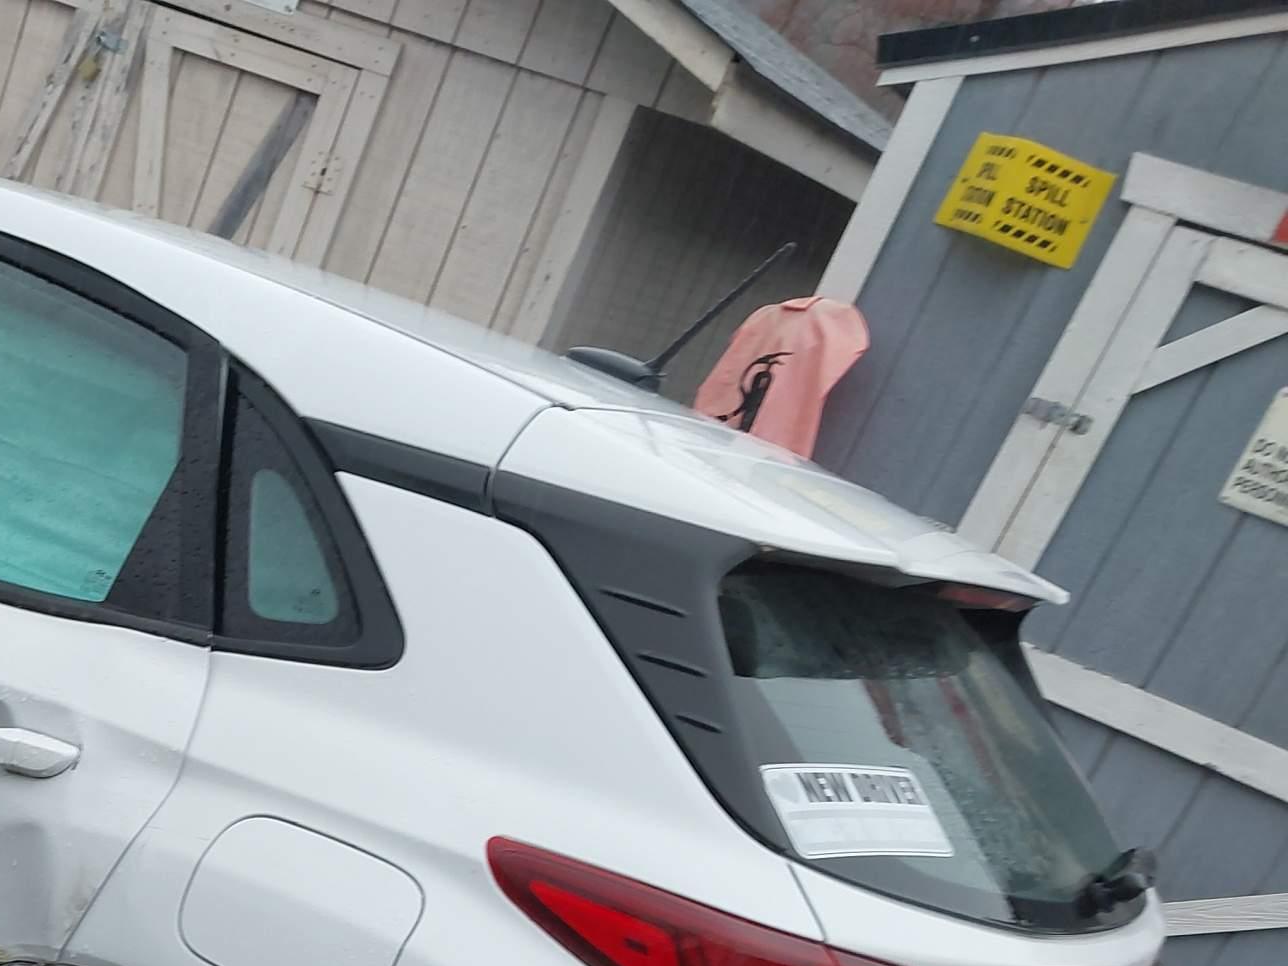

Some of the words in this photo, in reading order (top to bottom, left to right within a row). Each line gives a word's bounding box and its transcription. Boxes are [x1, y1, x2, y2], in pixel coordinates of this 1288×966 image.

[1025, 175, 1071, 208] SPILL
[1000, 196, 1070, 236] STATION
[794, 772, 854, 803] NEW
